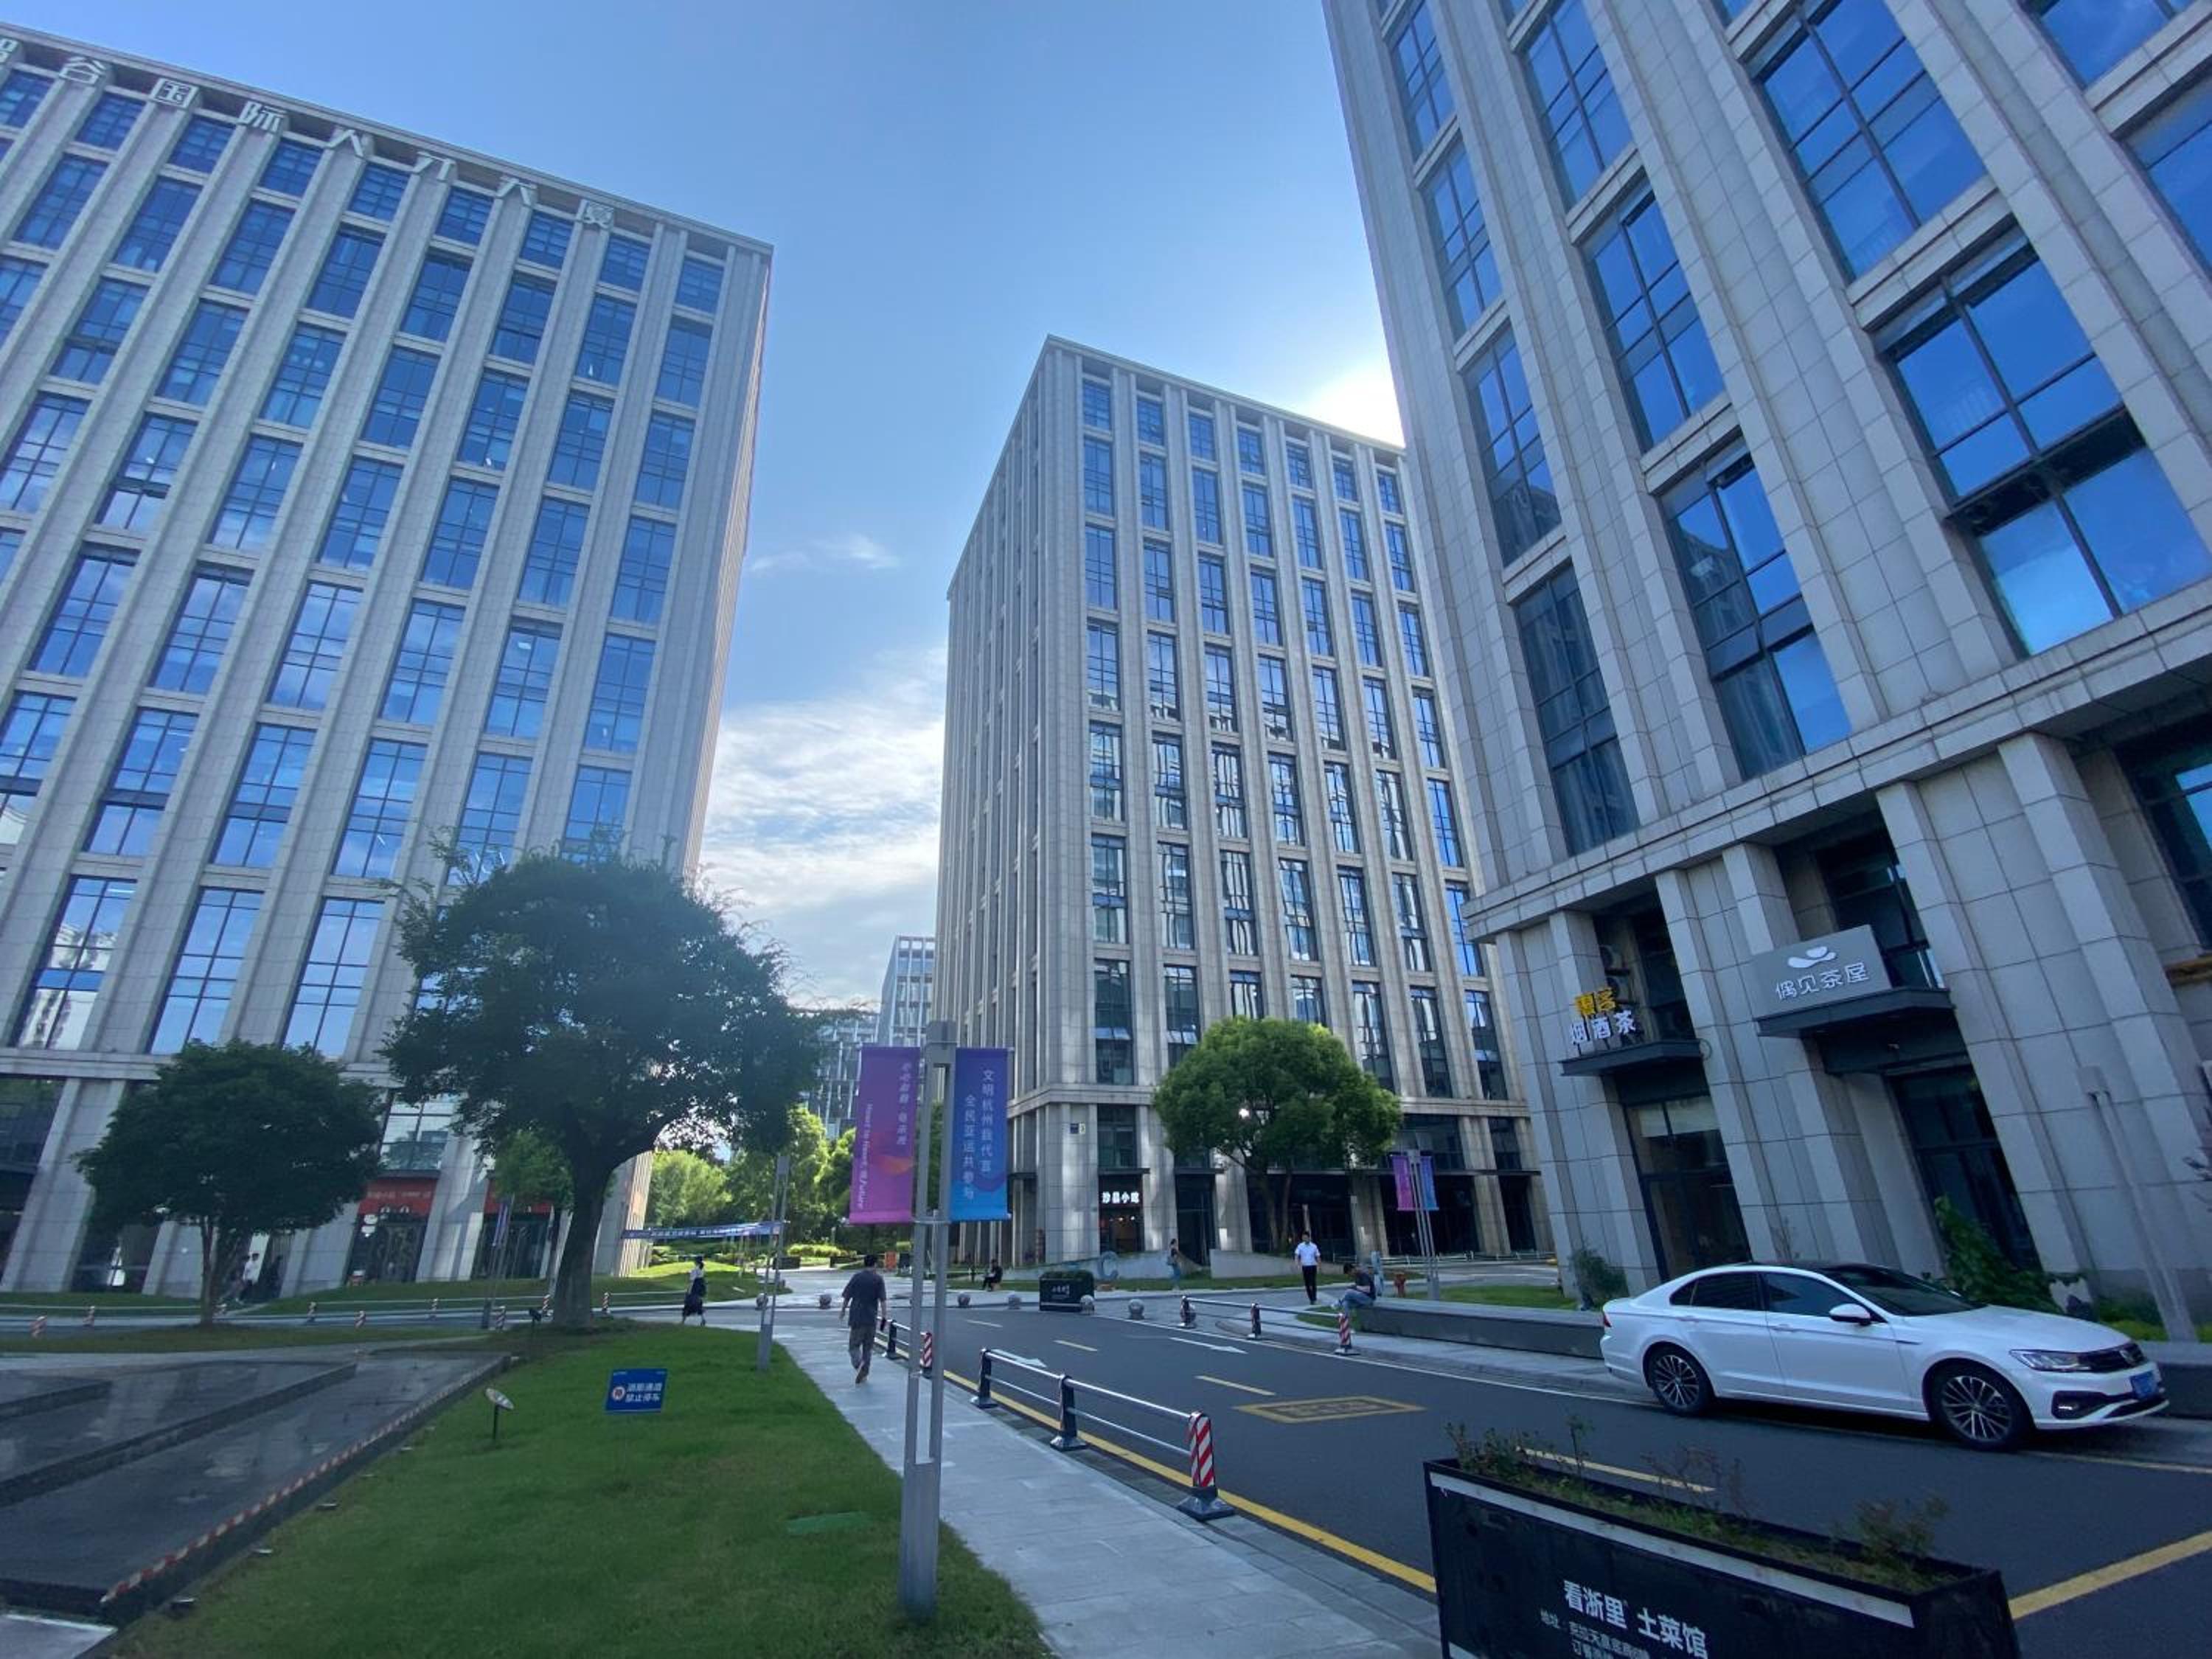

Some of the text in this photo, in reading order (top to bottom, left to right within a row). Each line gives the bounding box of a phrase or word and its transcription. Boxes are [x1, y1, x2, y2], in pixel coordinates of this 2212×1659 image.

[1774, 961, 1870, 1001] 偶见茶屋
[1564, 1579, 1628, 1630] 看浙里
[1637, 1607, 1709, 1659] 土菜馆
